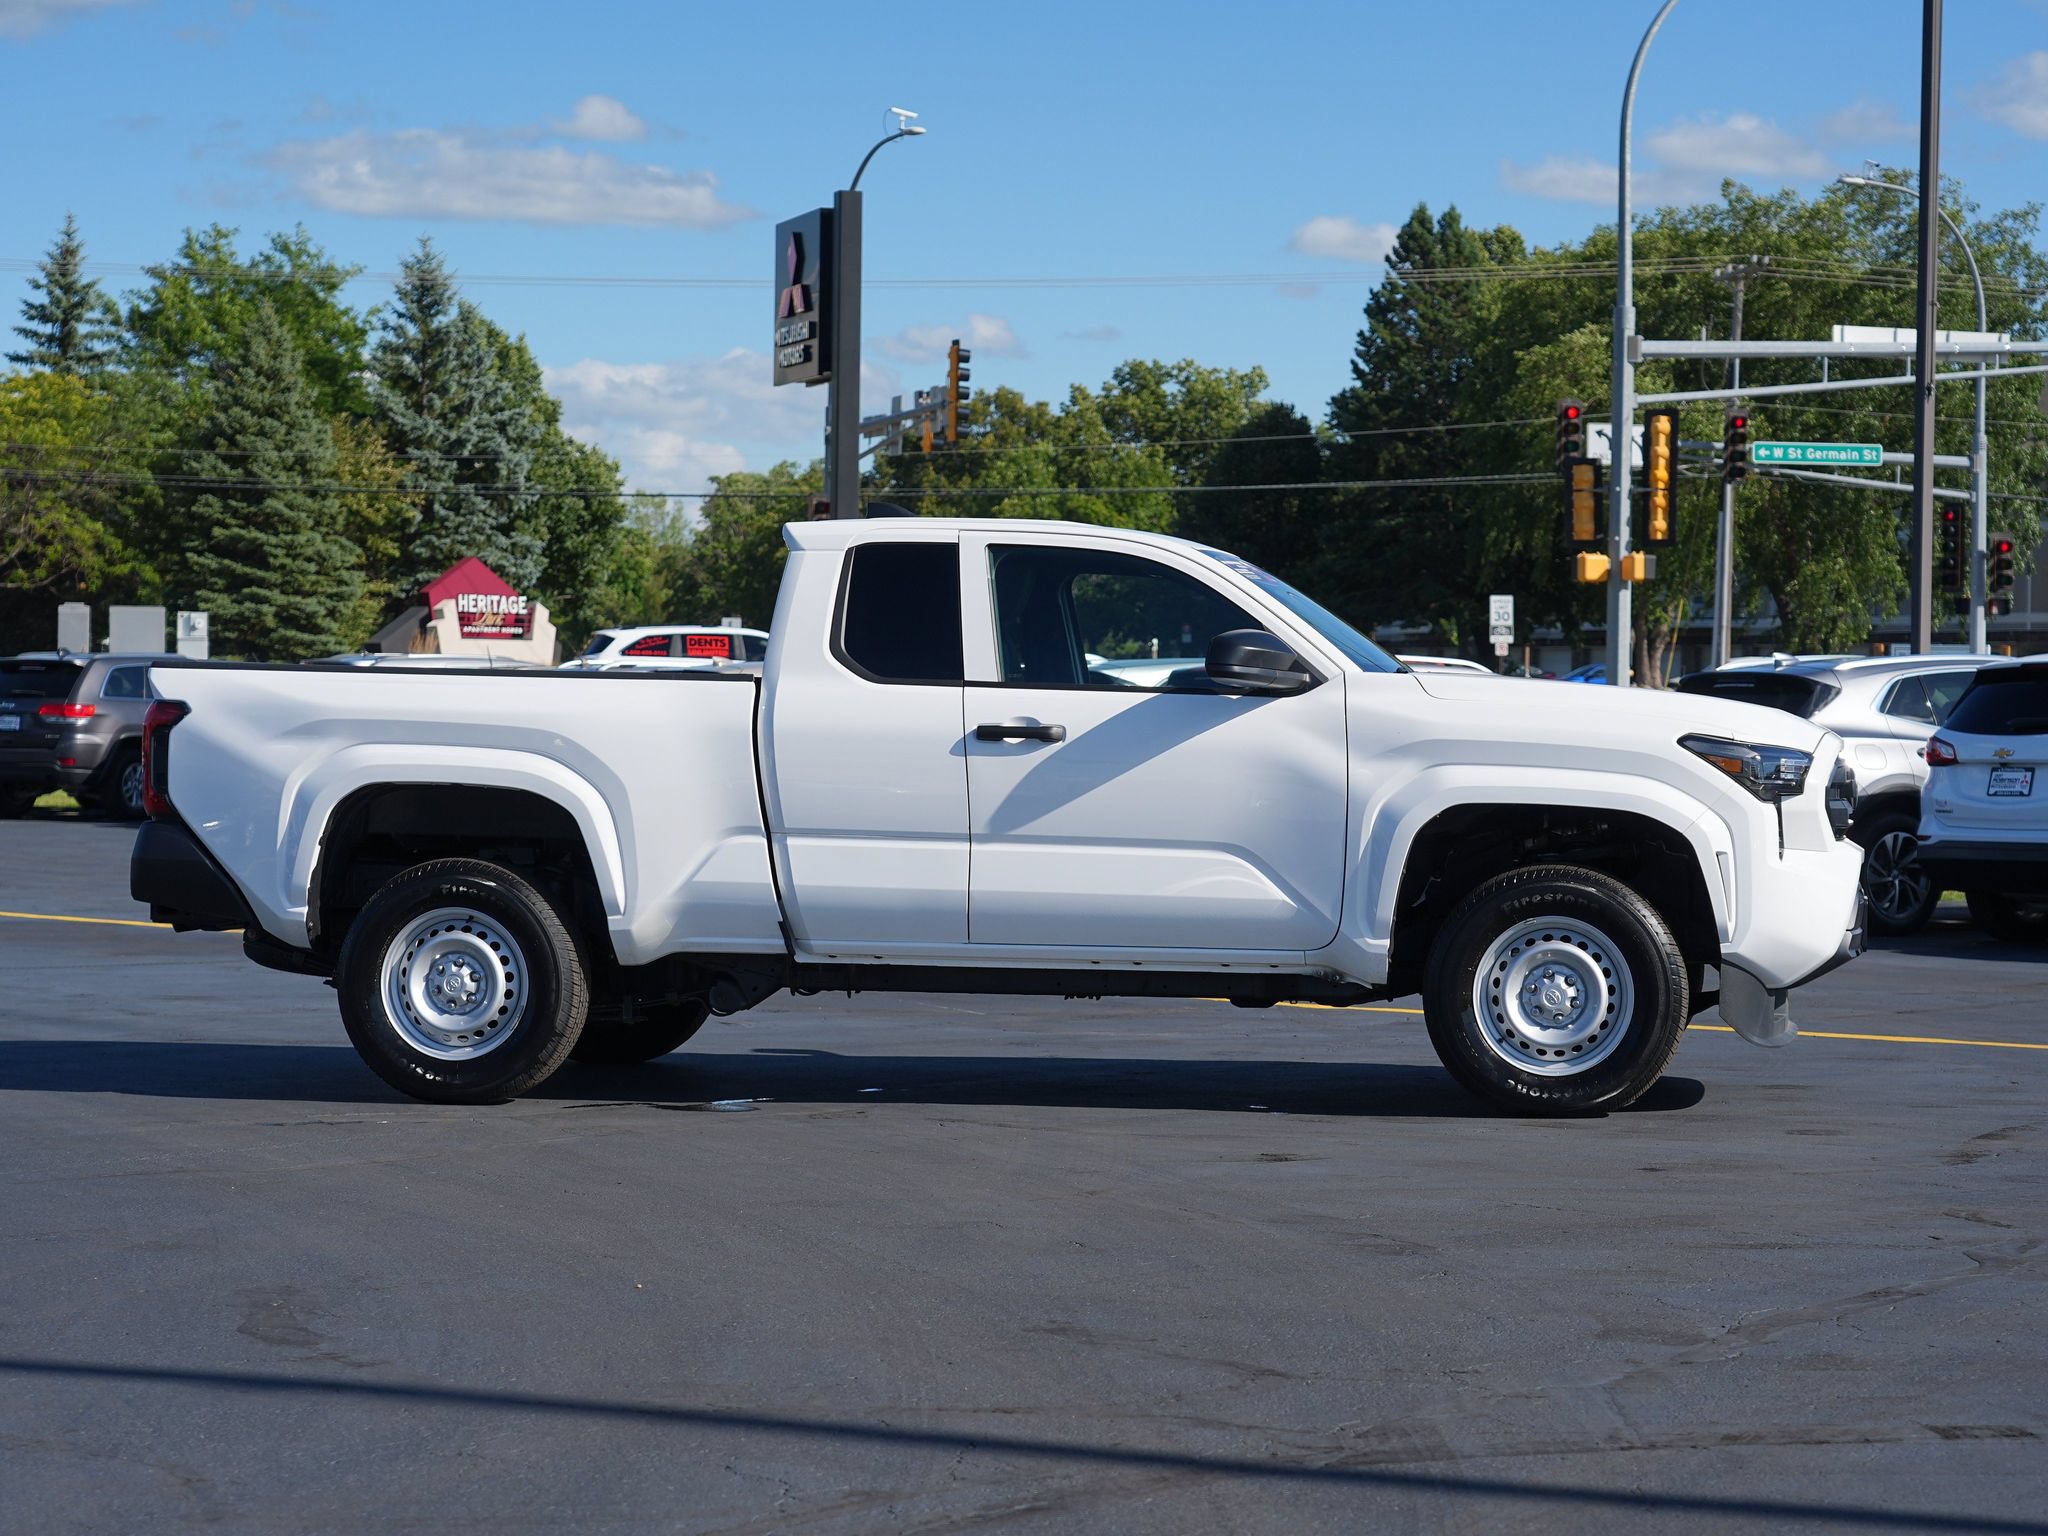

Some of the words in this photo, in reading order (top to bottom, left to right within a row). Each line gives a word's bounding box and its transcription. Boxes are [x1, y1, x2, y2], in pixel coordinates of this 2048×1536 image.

[1773, 446, 1784, 459] W
[1788, 447, 1803, 459] St
[1806, 448, 1860, 460] Germain
[1863, 448, 1878, 461] St
[457, 593, 528, 616] HERITAGE
[1494, 611, 1510, 622] 30
[689, 637, 727, 648] DENTS
